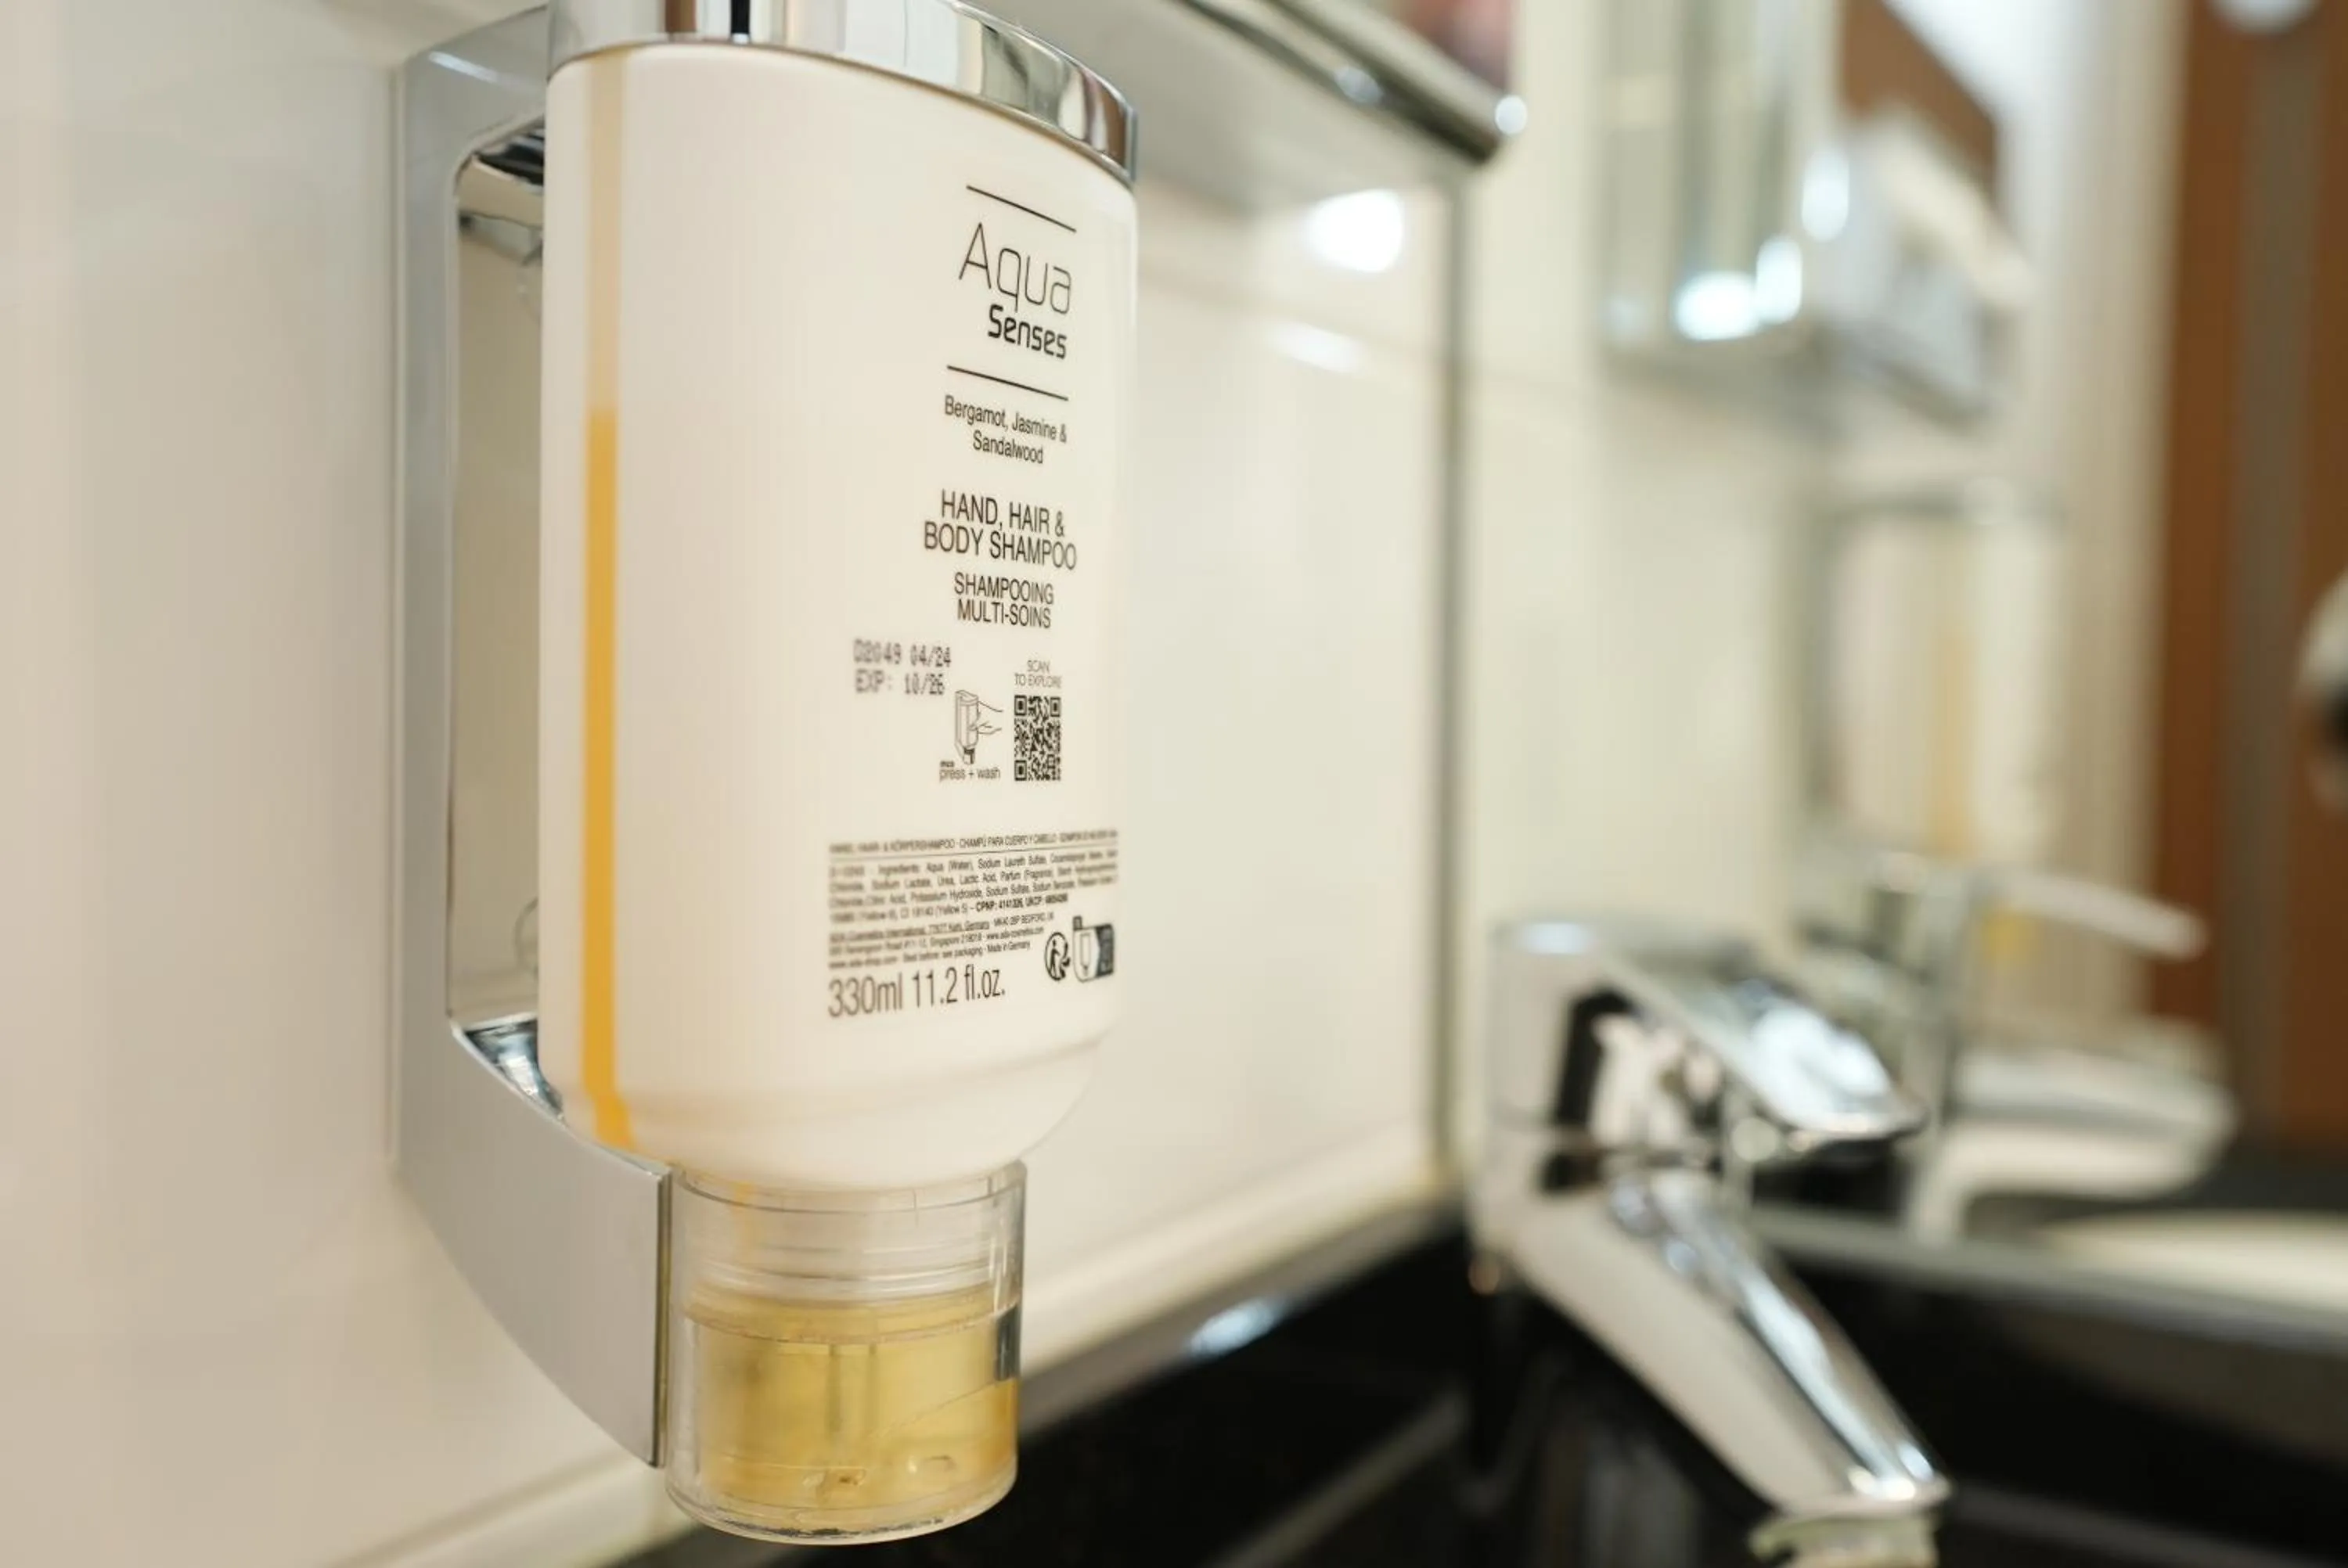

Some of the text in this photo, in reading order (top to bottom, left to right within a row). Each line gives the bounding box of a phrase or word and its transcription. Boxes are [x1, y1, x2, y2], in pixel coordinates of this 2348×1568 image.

[959, 222, 1071, 315] Aqua
[988, 304, 1067, 359] Senses
[945, 394, 1068, 444] Bergamot, Jasmine &
[973, 429, 1044, 464] Sandalwood
[941, 488, 1065, 538] HAND, HAIR &
[924, 520, 1078, 570] BODY SHAMPOO
[954, 571, 1054, 606] SHAMPOOING
[957, 598, 1051, 629] MULTI-SOINS
[910, 643, 952, 667] 04/24
[1014, 672, 1026, 686] TO
[939, 768, 966, 782] press
[977, 766, 1001, 780] wash
[828, 963, 1006, 1017] 330ml 11.2 fl.oz.
